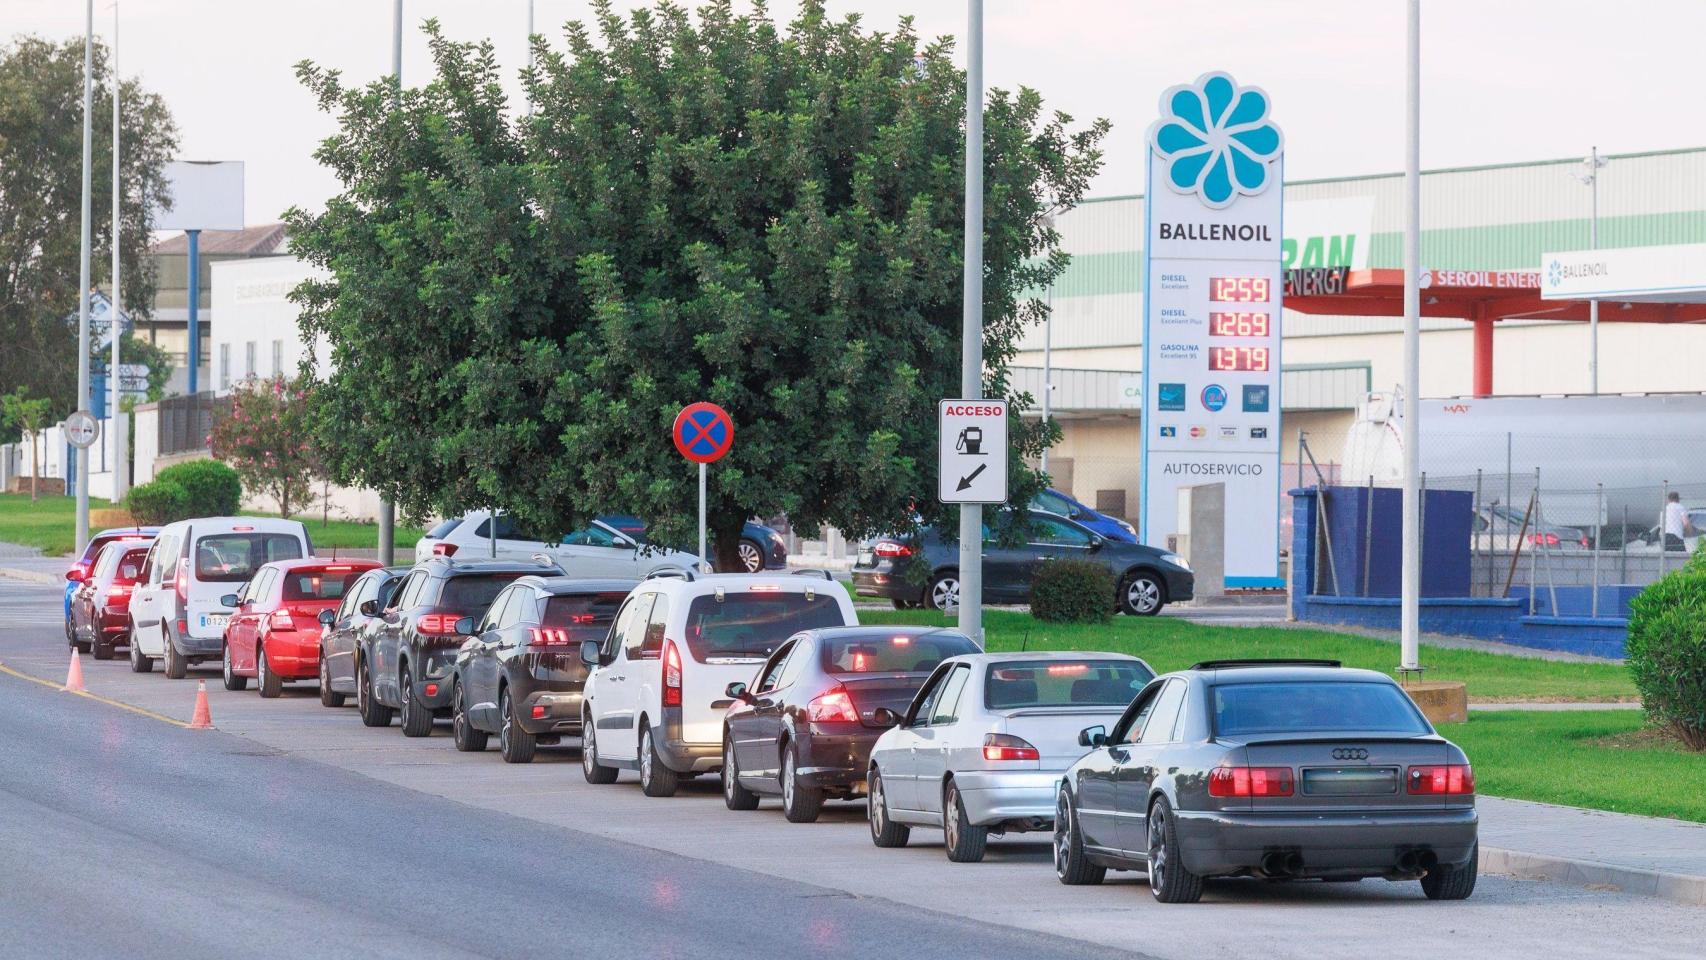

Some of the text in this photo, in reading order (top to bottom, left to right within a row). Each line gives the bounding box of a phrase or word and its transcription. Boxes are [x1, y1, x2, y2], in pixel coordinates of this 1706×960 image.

[1160, 223, 1271, 241] BALLENOIL
[1563, 263, 1609, 279] BALLENOIL
[1161, 274, 1187, 282] DIESEL
[1437, 271, 1493, 287] SEROIL
[1161, 309, 1187, 317] DIESEL
[1160, 344, 1199, 352] GASOLINA
[946, 406, 1002, 416] ACCESO
[1164, 463, 1263, 476] AUTOSERVICIO
